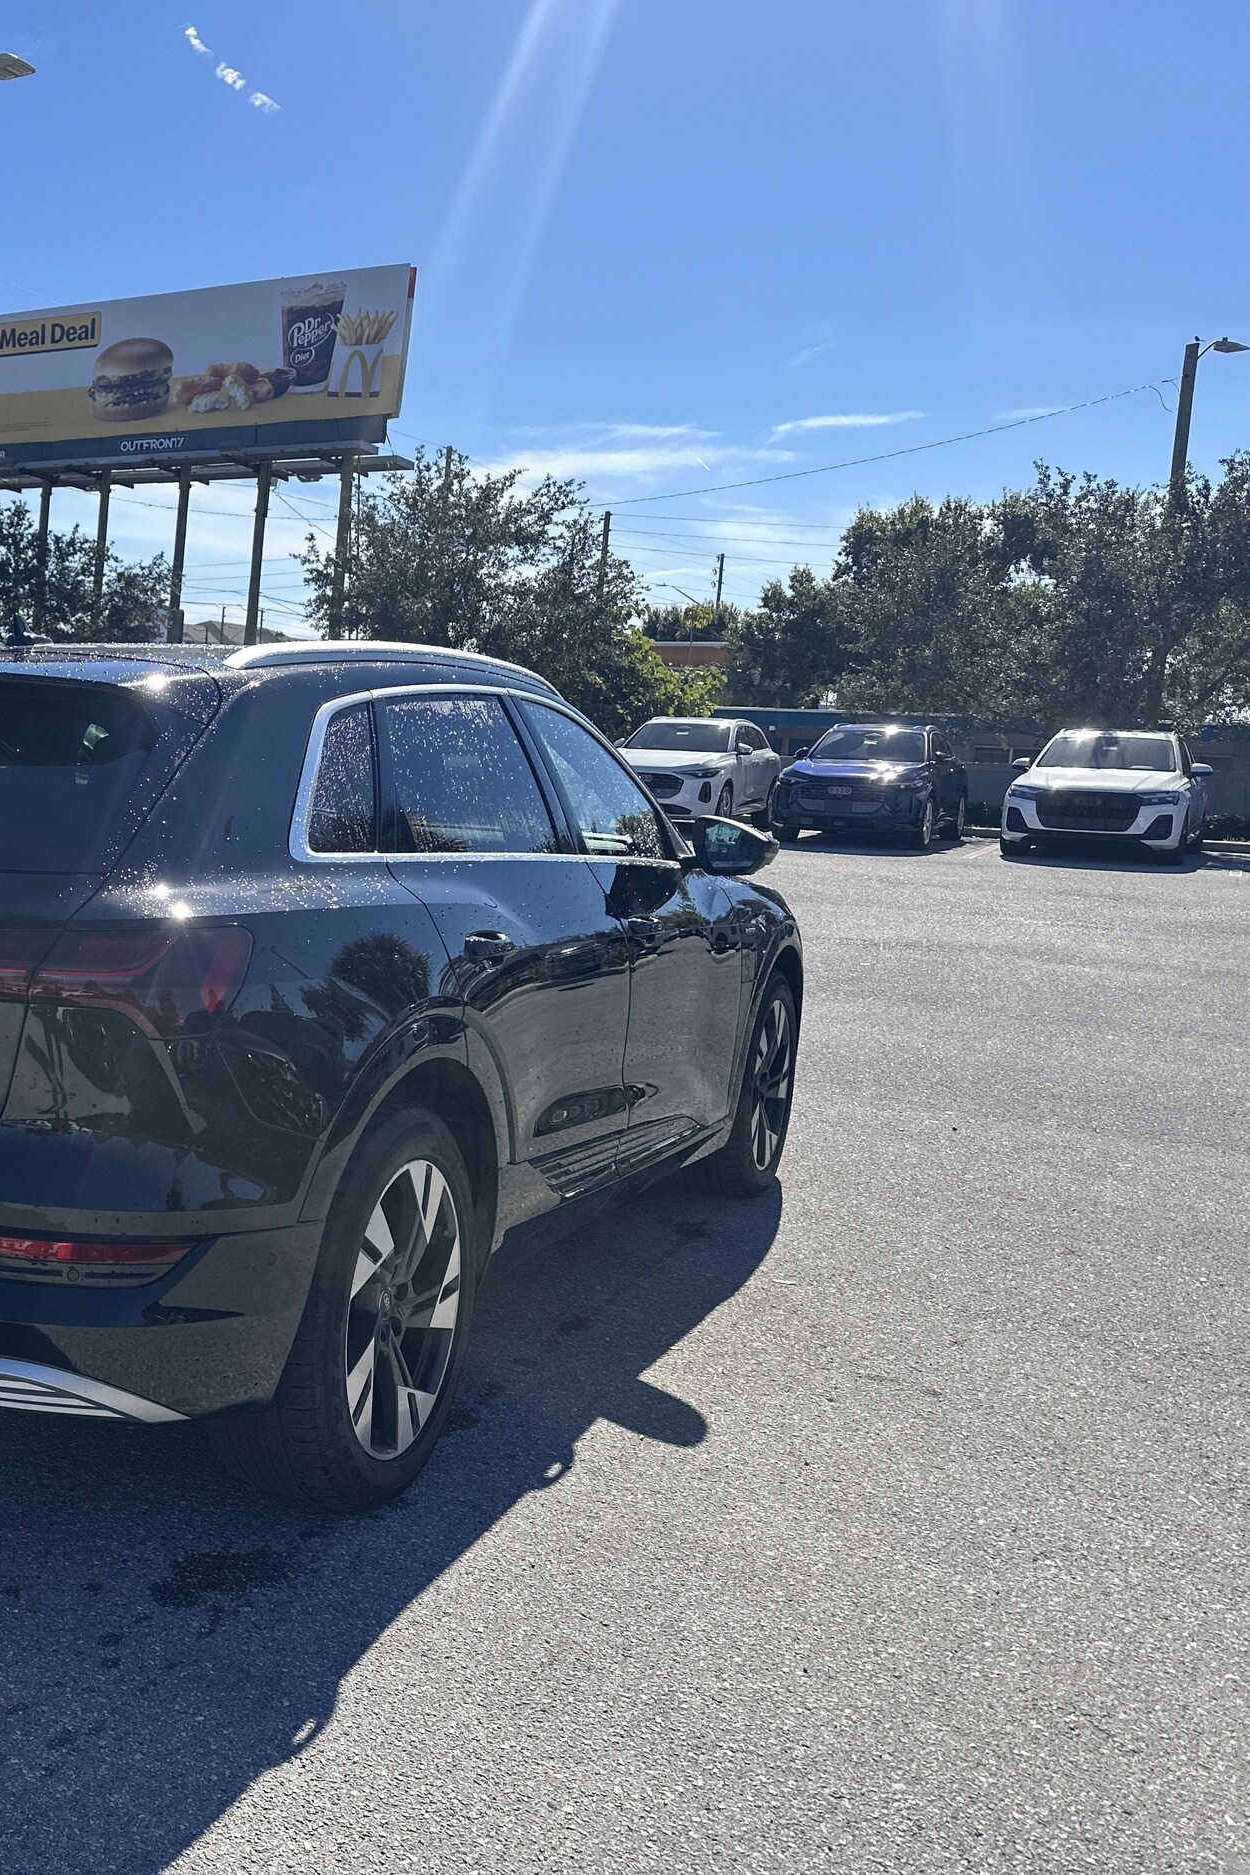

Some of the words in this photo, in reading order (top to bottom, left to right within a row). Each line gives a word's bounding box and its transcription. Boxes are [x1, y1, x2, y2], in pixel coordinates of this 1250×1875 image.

[0, 323, 47, 350] Meal
[50, 317, 96, 344] Deal
[288, 320, 331, 347] Pepper
[304, 317, 322, 333] Dr
[294, 351, 310, 363] Diet
